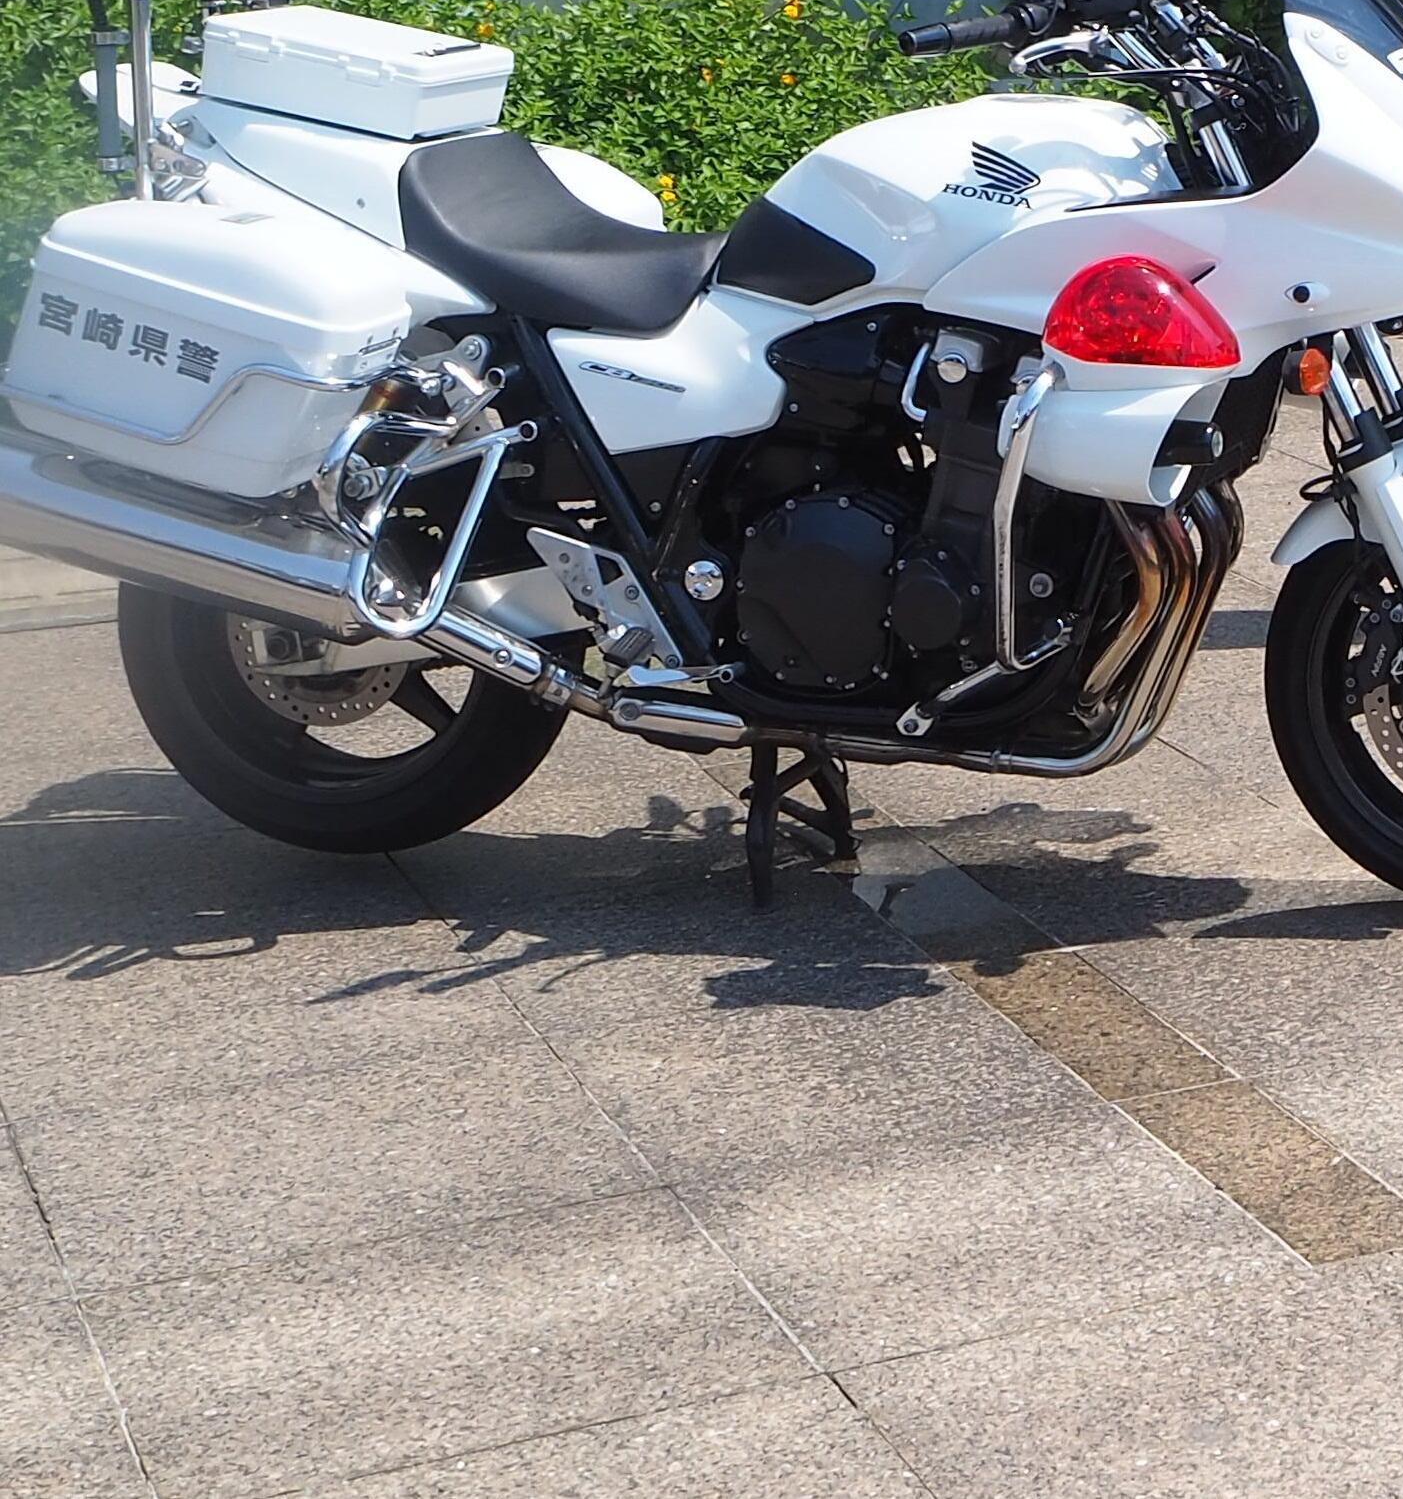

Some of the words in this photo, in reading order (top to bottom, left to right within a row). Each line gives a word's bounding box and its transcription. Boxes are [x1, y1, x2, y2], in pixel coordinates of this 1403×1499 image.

[942, 183, 1034, 211] HONDA
[38, 292, 220, 384] 宮崎県警
